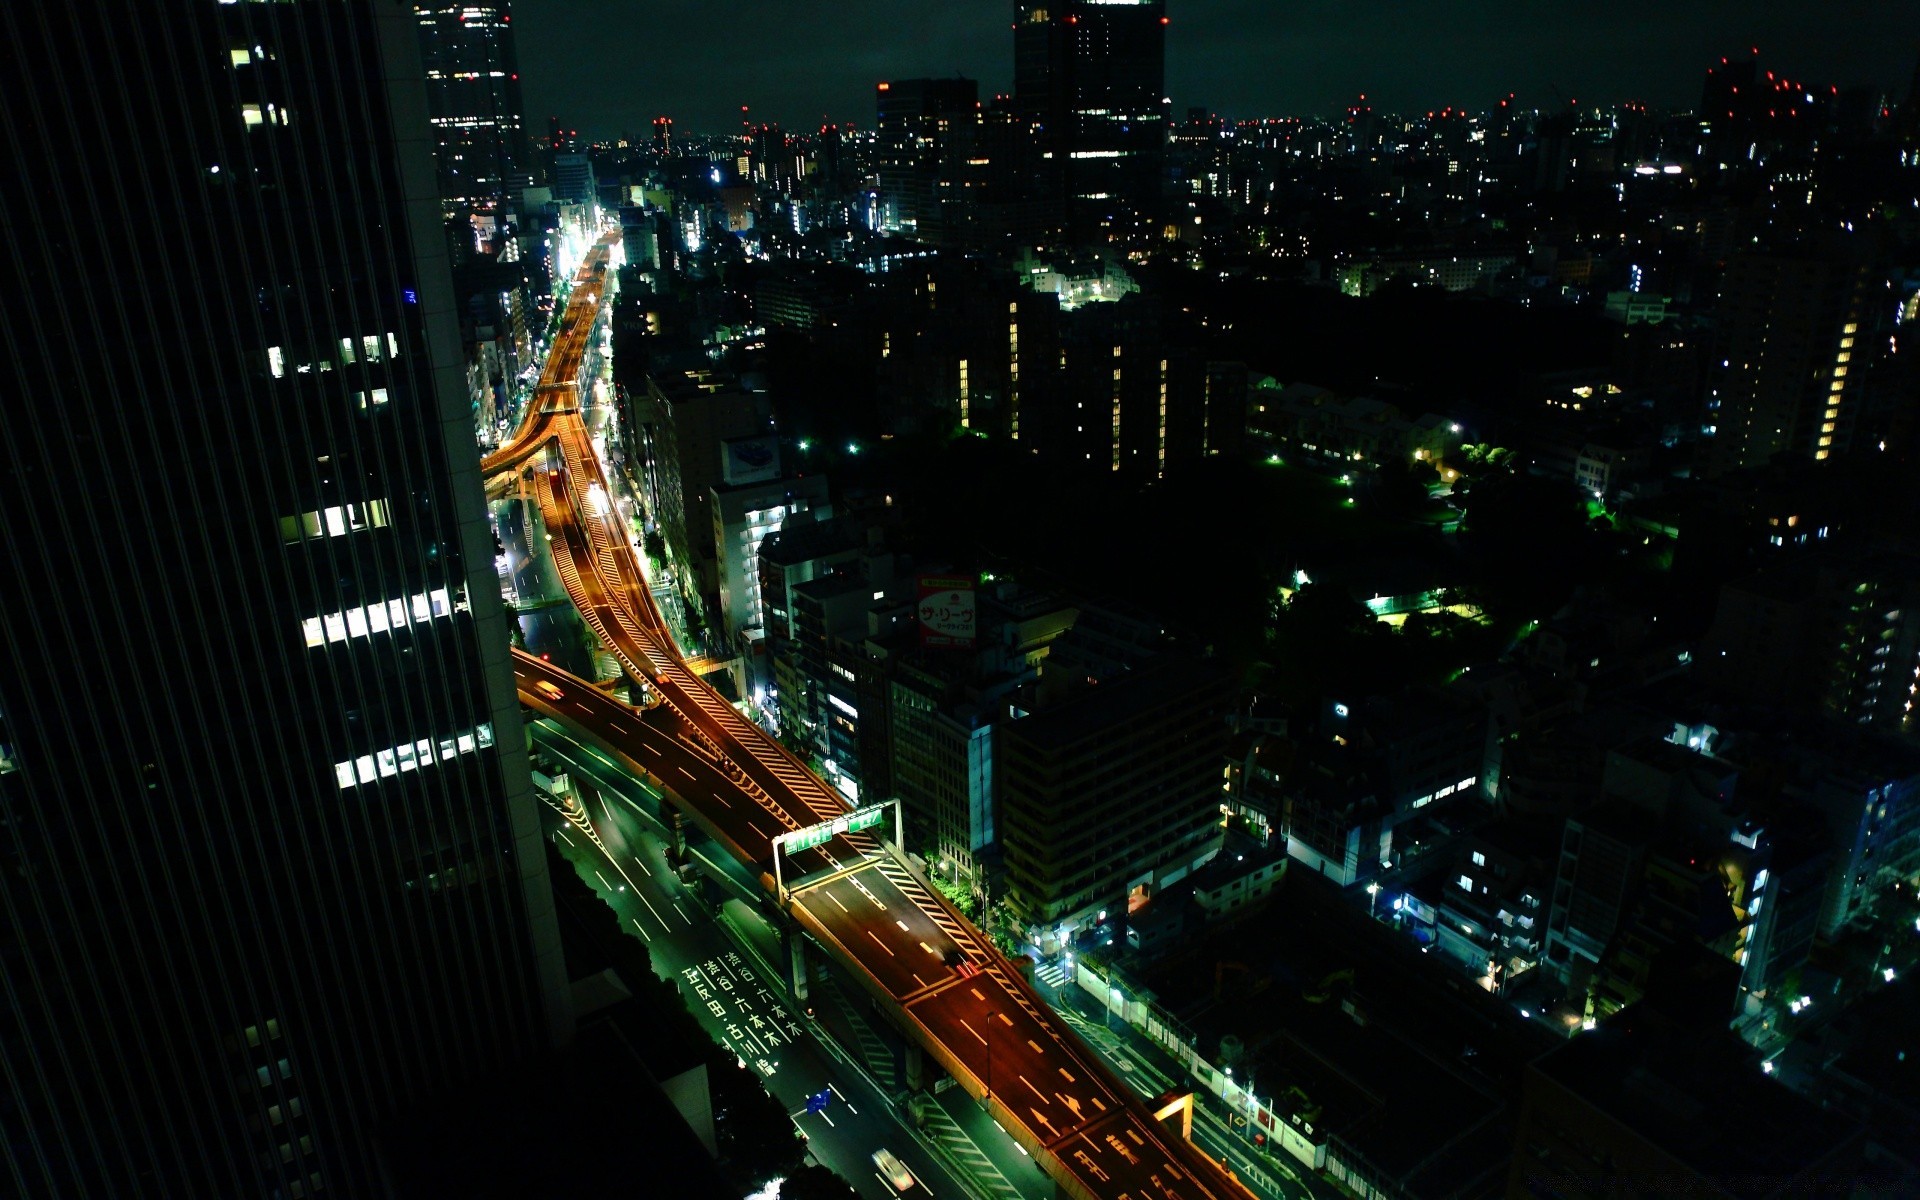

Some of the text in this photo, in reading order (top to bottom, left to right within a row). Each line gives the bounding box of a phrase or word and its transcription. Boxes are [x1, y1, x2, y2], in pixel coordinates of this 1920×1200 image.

[681, 968, 777, 1077] 五反田・古川橋
[704, 960, 781, 1046] 渋谷・六本木
[725, 953, 802, 1036] 渋谷・六本木
